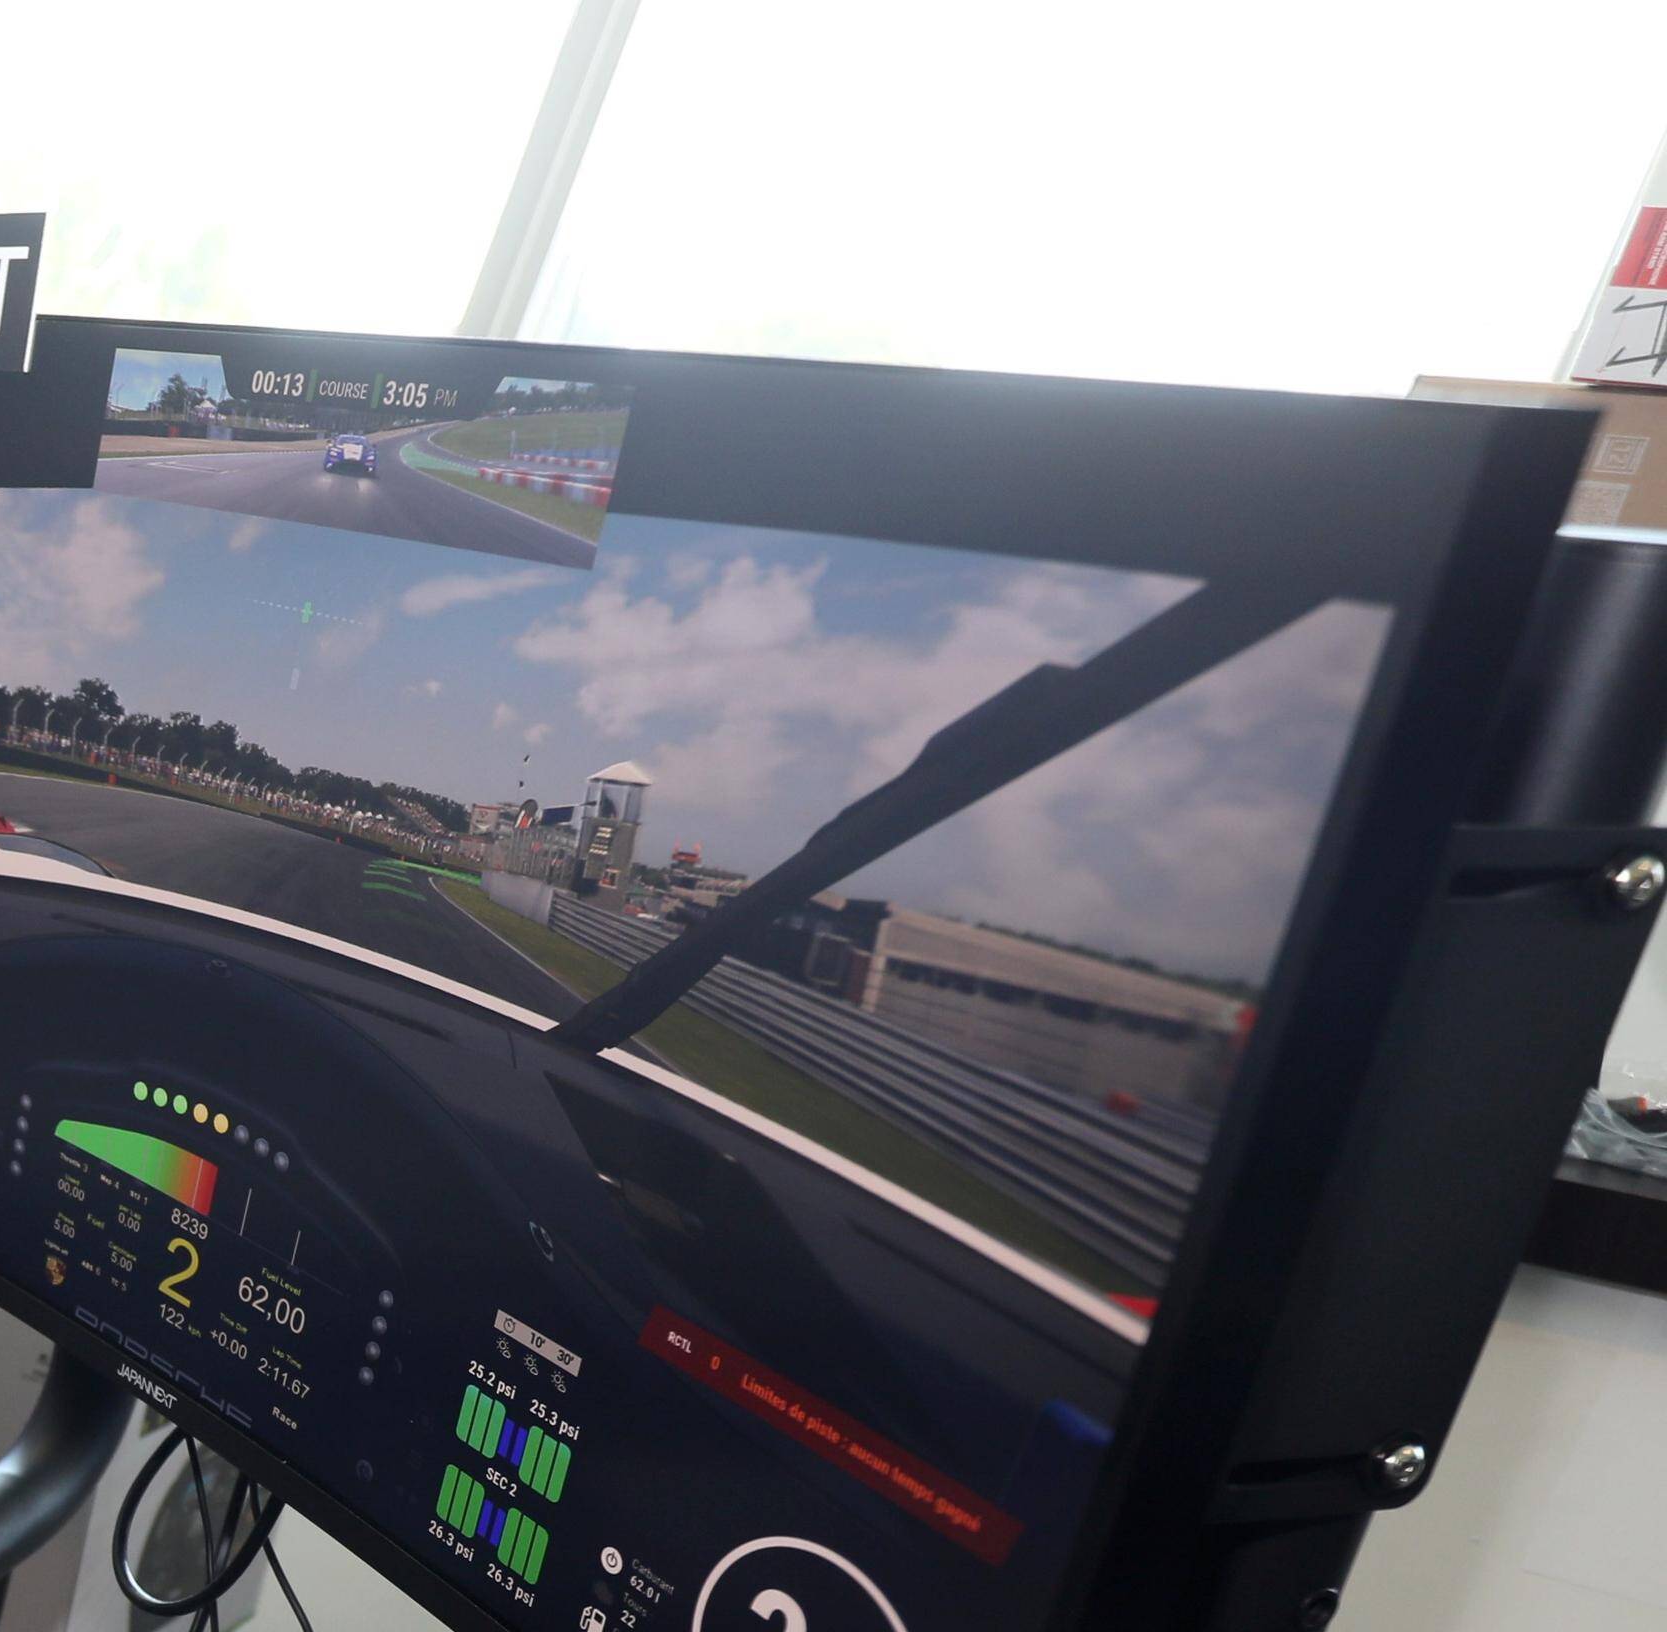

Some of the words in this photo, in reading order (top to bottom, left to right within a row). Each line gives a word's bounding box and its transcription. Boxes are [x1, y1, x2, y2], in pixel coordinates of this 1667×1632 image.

[251, 370, 305, 397] 00:13
[319, 380, 369, 400] COURSE
[383, 381, 429, 408] 3:05
[434, 388, 458, 408] PM
[57, 1178, 85, 1201] 00.00
[53, 1218, 76, 1239] 5.00
[118, 1212, 141, 1233] 0.00
[171, 1207, 209, 1240] 8239
[110, 1252, 133, 1272] 5.00
[158, 1237, 200, 1309] 2
[262, 1267, 280, 1284] Fuel
[280, 1279, 302, 1297] Level
[159, 1303, 185, 1330] 122
[238, 1276, 306, 1334] 62,00
[210, 1329, 248, 1360] +0.00
[272, 1346, 287, 1362] Lap
[117, 1363, 178, 1410] JAPANNEXT
[257, 1357, 310, 1399] 2:11.67
[468, 1360, 496, 1387] 25.2
[496, 1379, 517, 1400] psi
[272, 1406, 298, 1431] Race
[529, 1399, 558, 1427] 25.3
[559, 1418, 581, 1441] psi
[667, 1331, 693, 1355] RCTL
[740, 1373, 786, 1412] Limites
[788, 1402, 806, 1422] de
[806, 1413, 840, 1444] piste
[849, 1441, 891, 1475] aucun
[892, 1465, 934, 1502] temps
[485, 1467, 509, 1491] SEC
[509, 1483, 518, 1498] 2
[428, 1520, 455, 1548] 26.3
[455, 1541, 475, 1562] psi
[486, 1563, 514, 1592] 26.3
[515, 1585, 536, 1608] psi
[630, 1575, 654, 1598] 62.0
[631, 1558, 675, 1595] Carburant
[620, 1609, 637, 1629] 22
